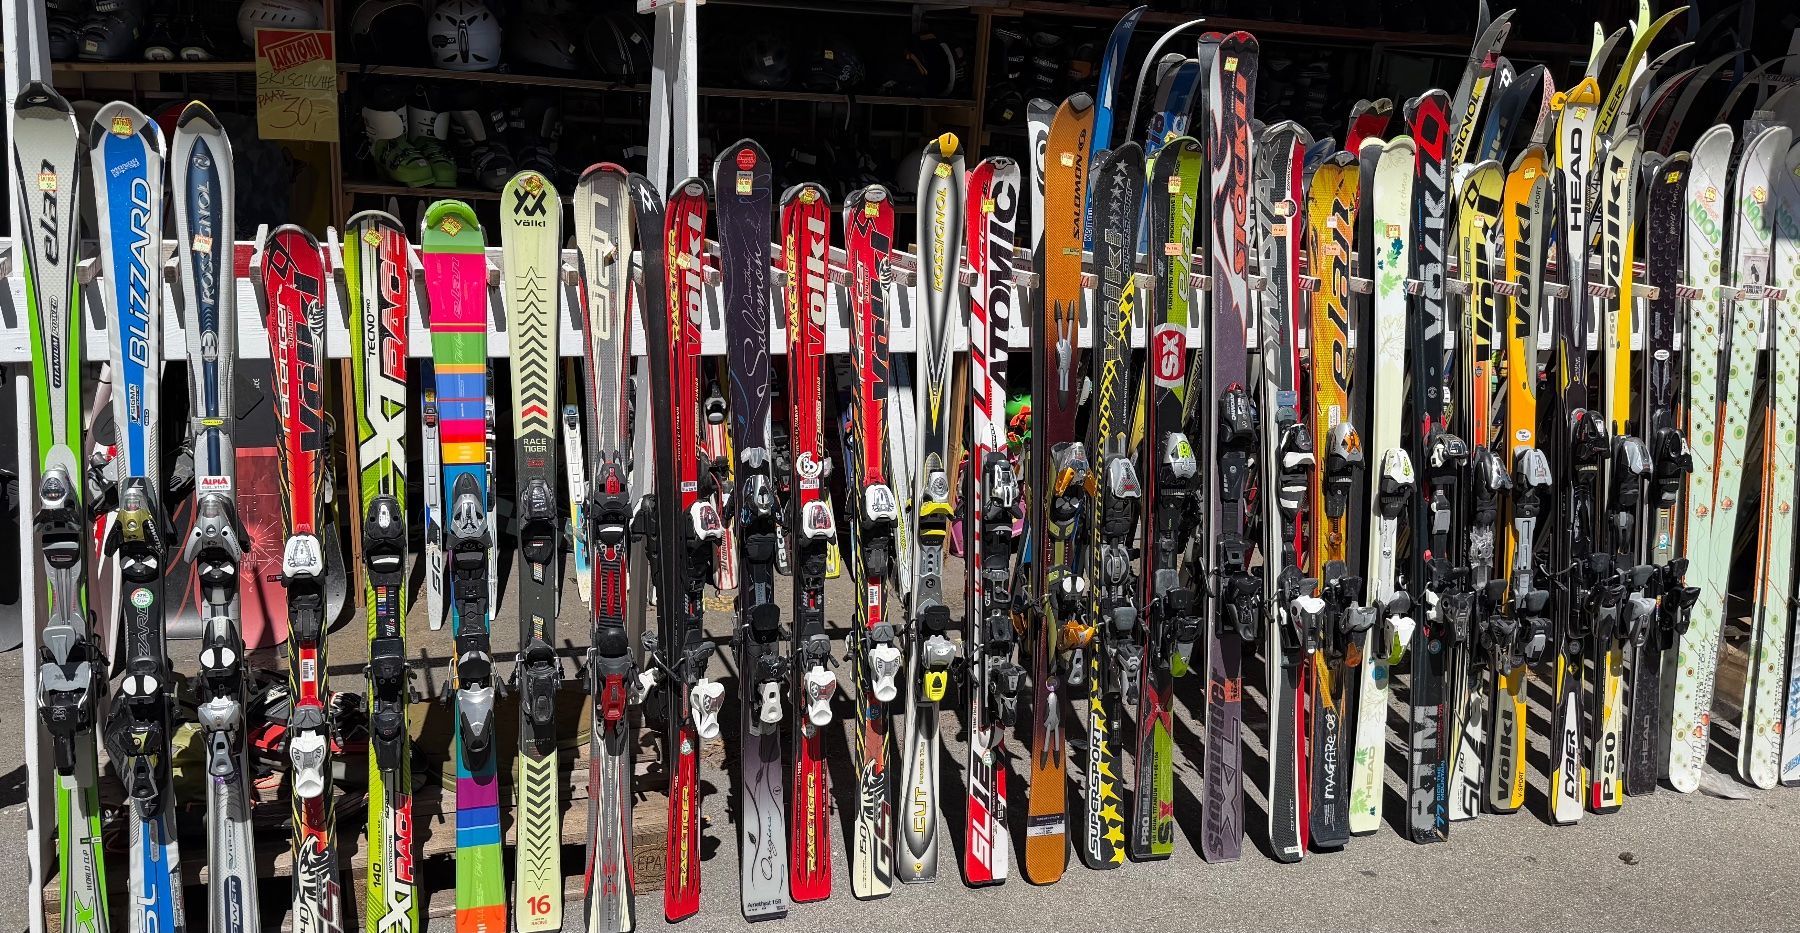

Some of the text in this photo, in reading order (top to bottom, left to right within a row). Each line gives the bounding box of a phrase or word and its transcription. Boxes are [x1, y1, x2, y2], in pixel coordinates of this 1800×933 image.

[271, 35, 320, 69] AKTION
[1073, 154, 1083, 240] SALOMON
[1533, 186, 1542, 215] V-SPORT
[1570, 127, 1582, 232] HEAD
[196, 181, 215, 304] ROSSGNOL
[513, 217, 547, 228] Völkl
[931, 187, 948, 293] ROSSIGNOL
[1176, 192, 1193, 302] elan
[590, 192, 611, 341] elan
[806, 216, 826, 357] Völkl
[989, 180, 1015, 391] ATOMIC
[1327, 198, 1351, 394] elan
[1463, 236, 1472, 339] RACEIGER
[1514, 201, 1532, 339] Völkl
[380, 223, 408, 381] RACE
[741, 240, 769, 378] Salomon
[50, 298, 60, 387] TITANIUM POWER
[367, 313, 376, 358] TECNO
[1161, 332, 1179, 377] SX
[148, 514, 164, 555] SALOMON
[1411, 705, 1437, 831] RTM
[1497, 709, 1513, 801] Völkl
[1564, 729, 1576, 799] CYBER
[1641, 715, 1650, 764] HEAD
[1087, 716, 1101, 860] SUPERSPORT
[1366, 746, 1376, 799] HEAD
[1462, 762, 1481, 818] SL
[1517, 771, 1525, 798] V-SPORT
[859, 825, 867, 855] 150
[913, 786, 927, 841] CUT
[1141, 816, 1150, 846] PRO
[1436, 804, 1445, 828] 77
[83, 864, 93, 891] WORLD
[372, 863, 381, 888] 140
[526, 895, 551, 916] 16
[299, 906, 309, 933] 40
